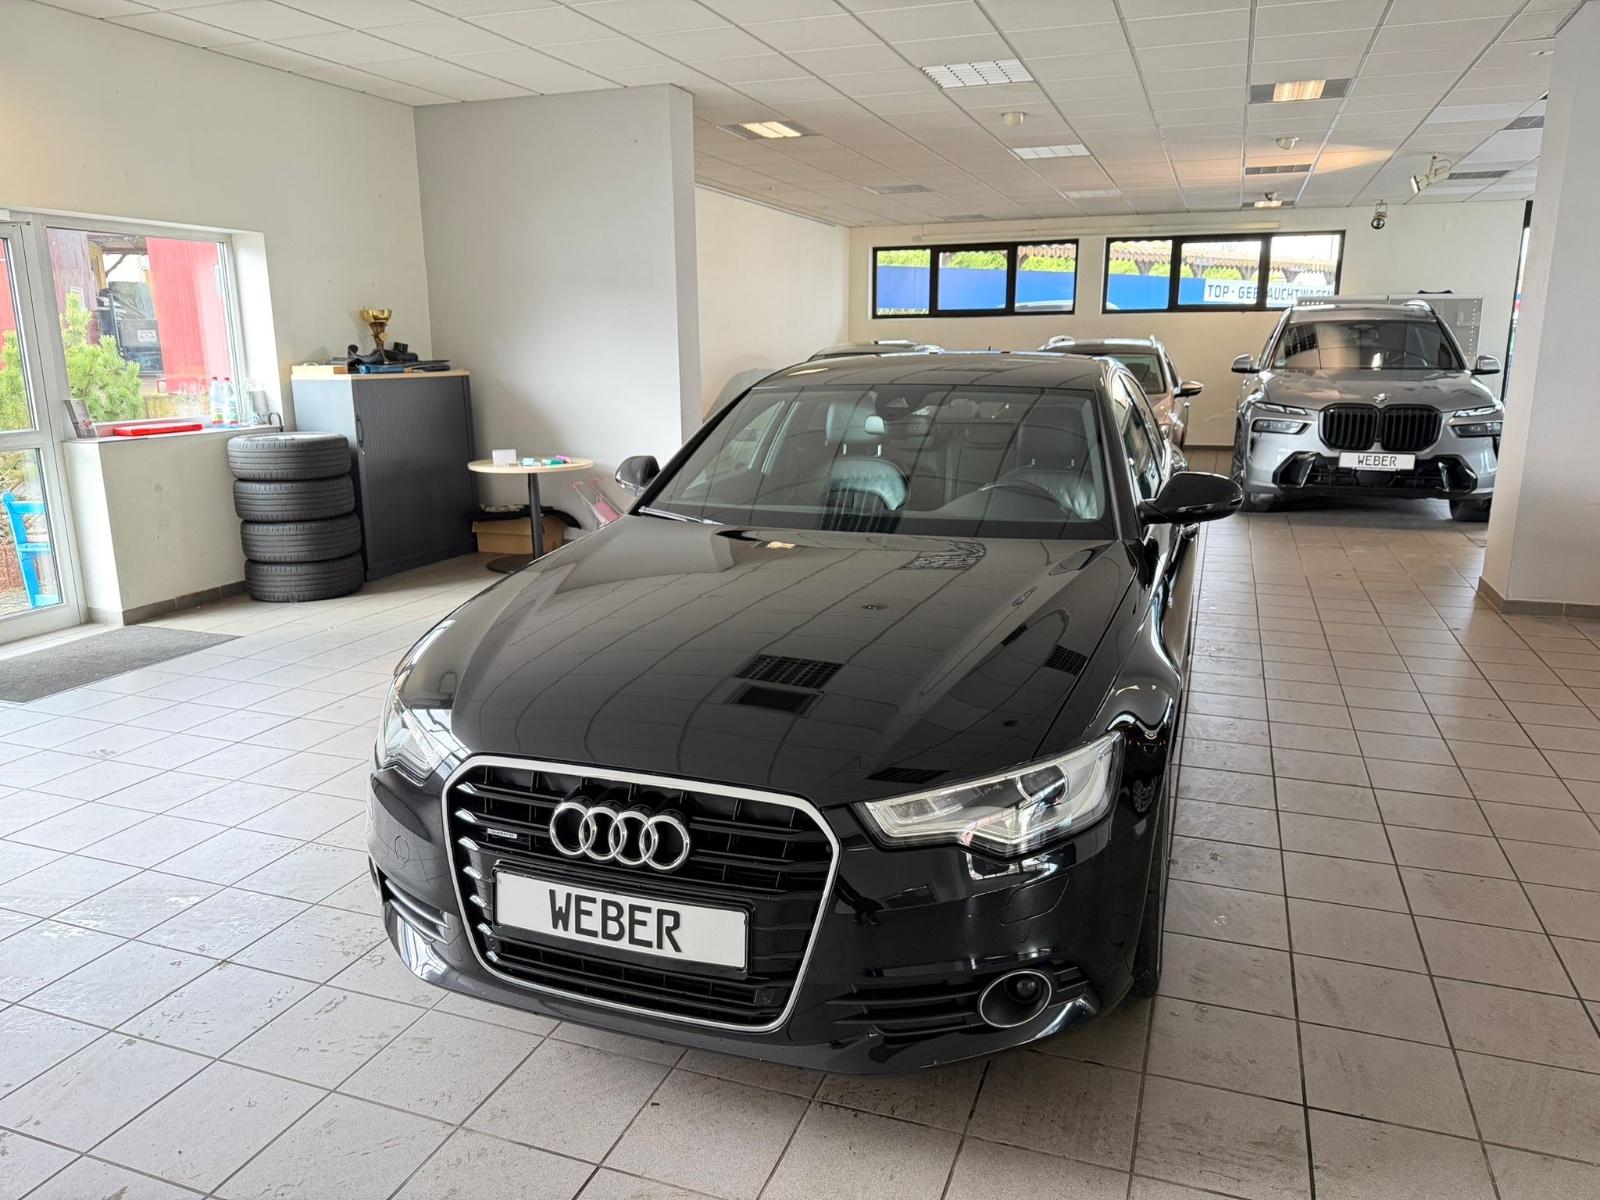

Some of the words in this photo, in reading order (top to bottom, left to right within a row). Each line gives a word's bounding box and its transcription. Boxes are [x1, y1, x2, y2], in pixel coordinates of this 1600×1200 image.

[1207, 284, 1229, 298] TOP
[1357, 455, 1397, 467] WEBER
[549, 889, 682, 952] WEBER
